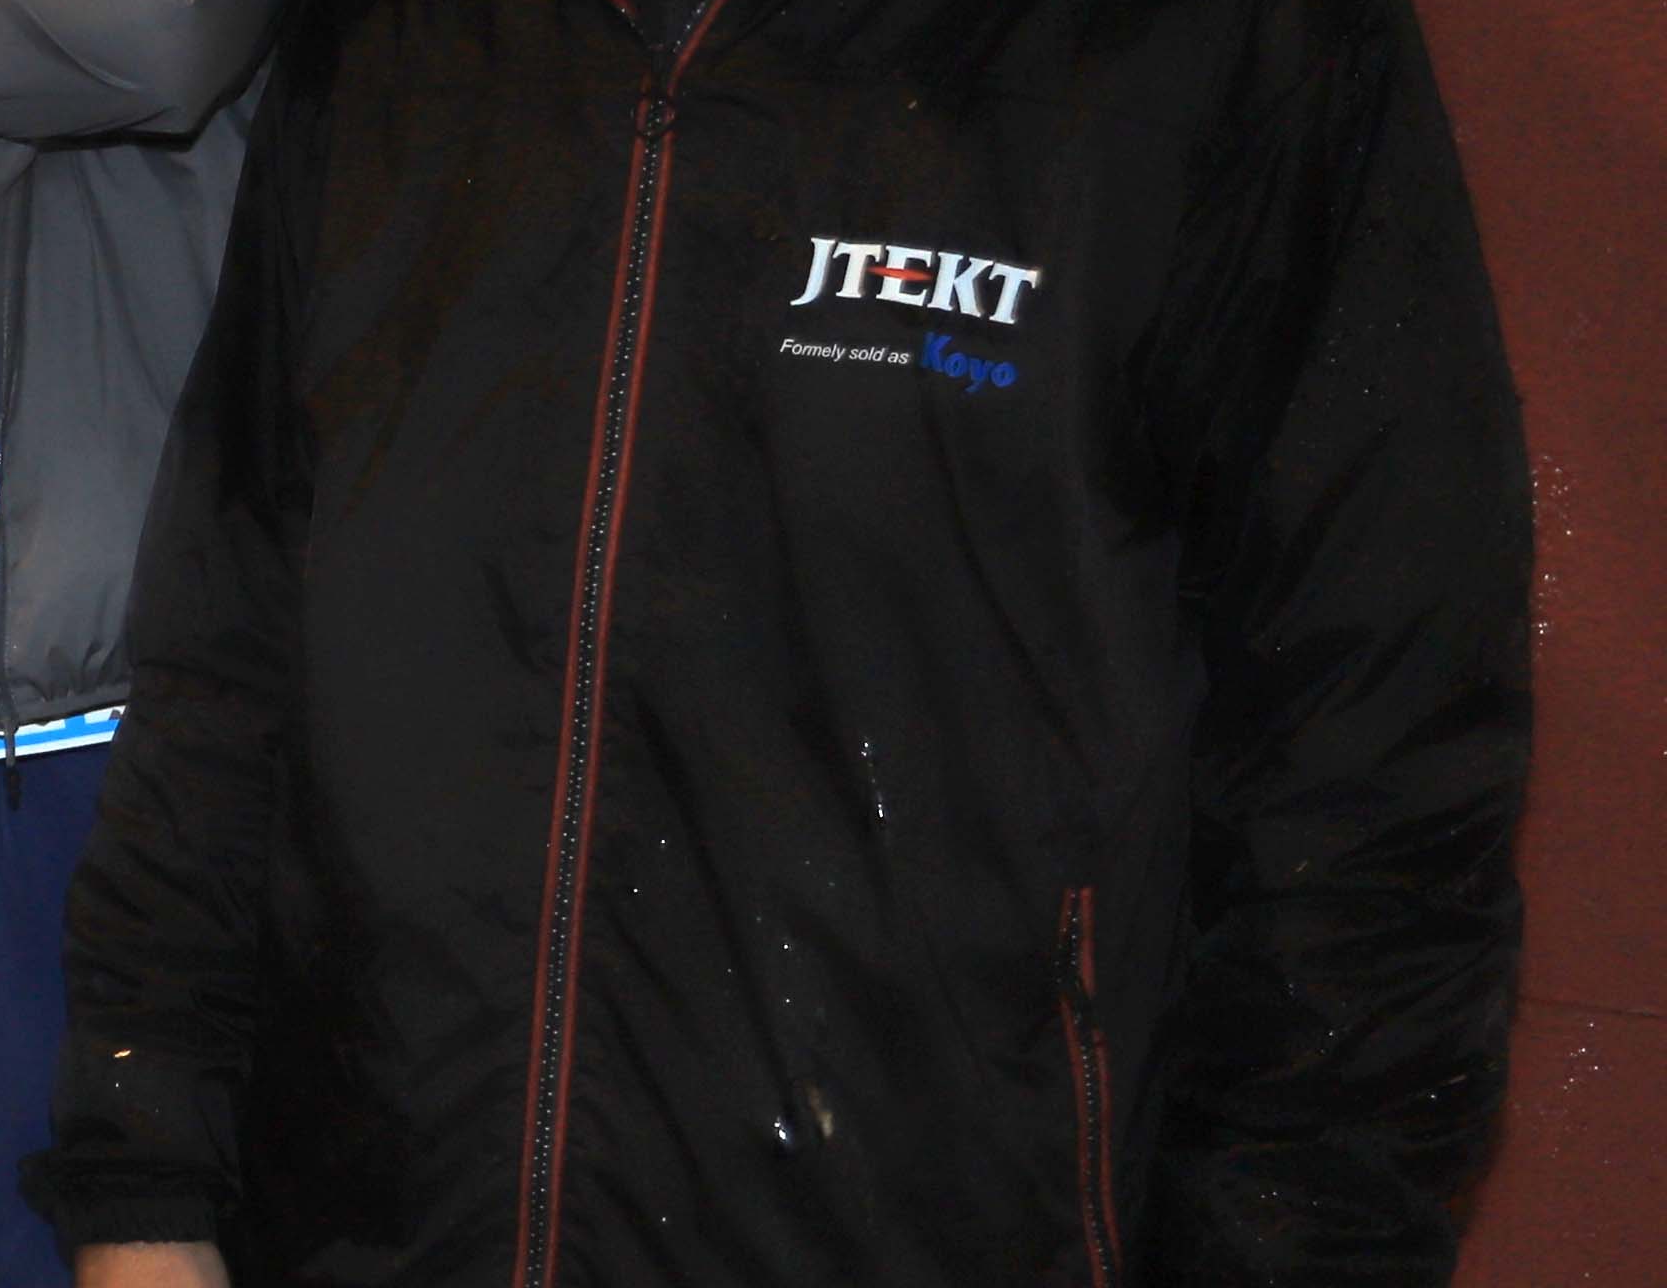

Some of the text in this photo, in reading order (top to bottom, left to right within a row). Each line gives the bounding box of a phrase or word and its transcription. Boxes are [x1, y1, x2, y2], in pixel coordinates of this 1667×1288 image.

[790, 237, 1042, 325] JTEKT
[779, 331, 1017, 393] Formely sold as Koyo
